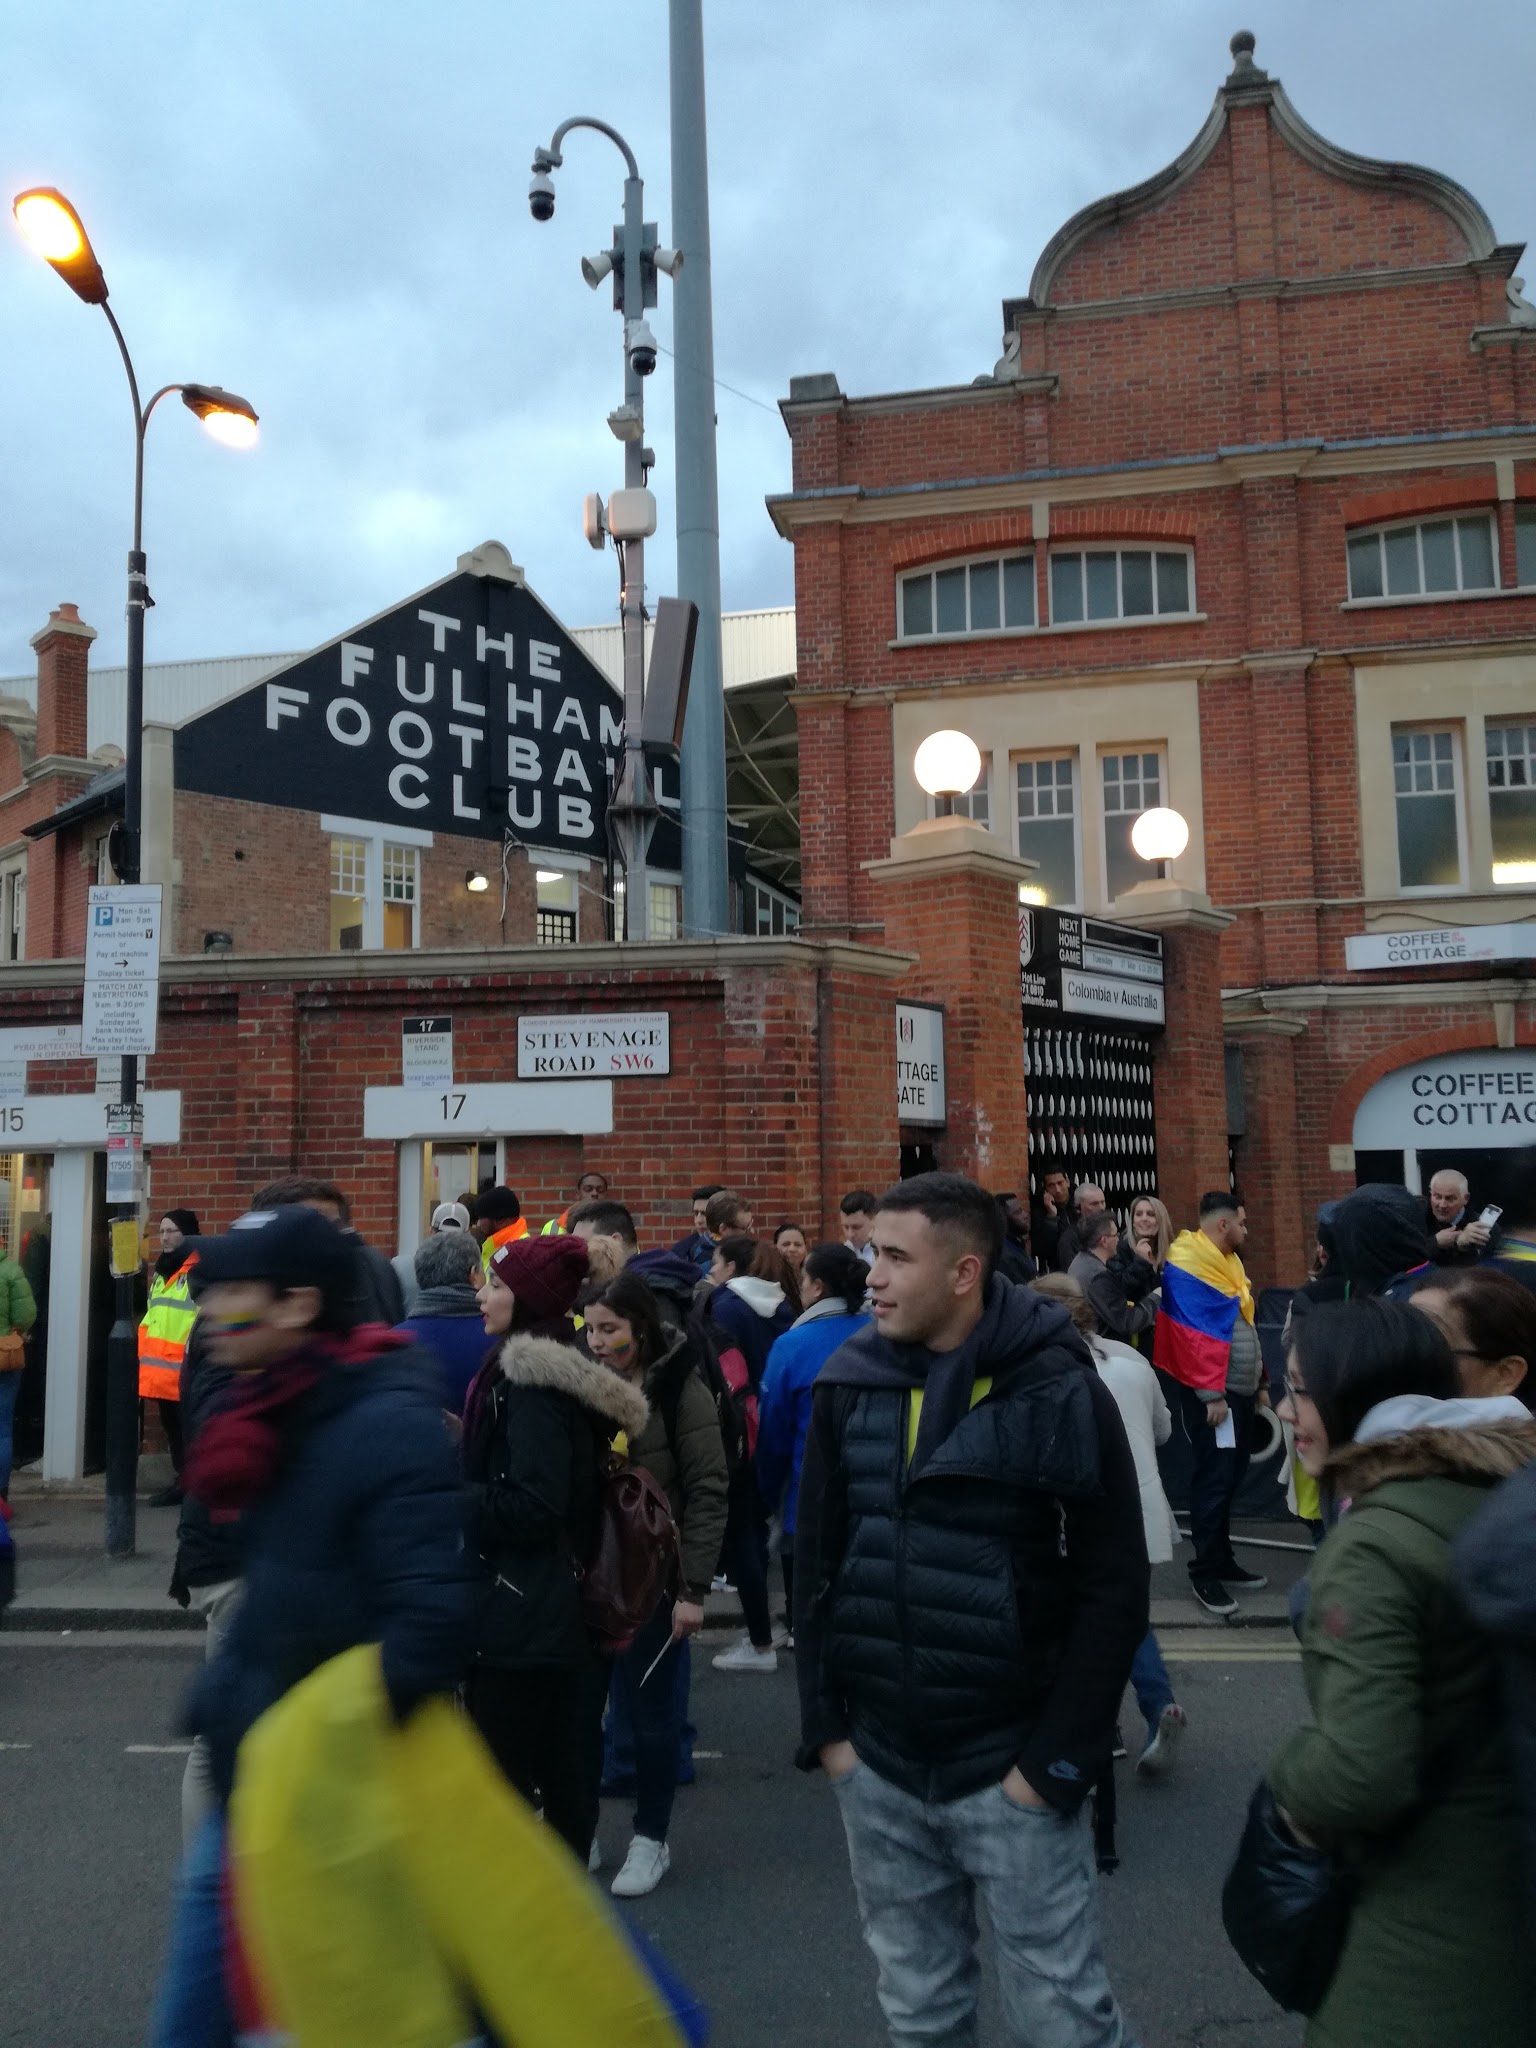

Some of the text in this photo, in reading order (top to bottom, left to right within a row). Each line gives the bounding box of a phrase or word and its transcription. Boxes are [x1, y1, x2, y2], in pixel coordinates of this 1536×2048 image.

[418, 609, 561, 682] THE
[389, 763, 594, 838] CLUB
[1059, 917, 1079, 933] NEXT
[1058, 932, 1080, 949] HOME
[1387, 931, 1451, 948] COFFEE
[1059, 948, 1081, 965] GAME
[1388, 945, 1467, 962] COTTAGE
[1067, 980, 1158, 1010] Colombia v Australia
[419, 1020, 434, 1032] 17
[13, 1043, 35, 1051] PYRO
[407, 1036, 446, 1044] RIVERSIDE
[524, 1029, 662, 1050] STEVENAGE
[534, 1053, 655, 1073] ROAD SW6
[1411, 1072, 1535, 1097] COFFEE
[109, 1104, 121, 1113] Pay
[122, 1104, 132, 1113] by
[440, 1094, 467, 1120] 17
[0, 1107, 24, 1133] 15
[110, 1161, 132, 1170] 17505
